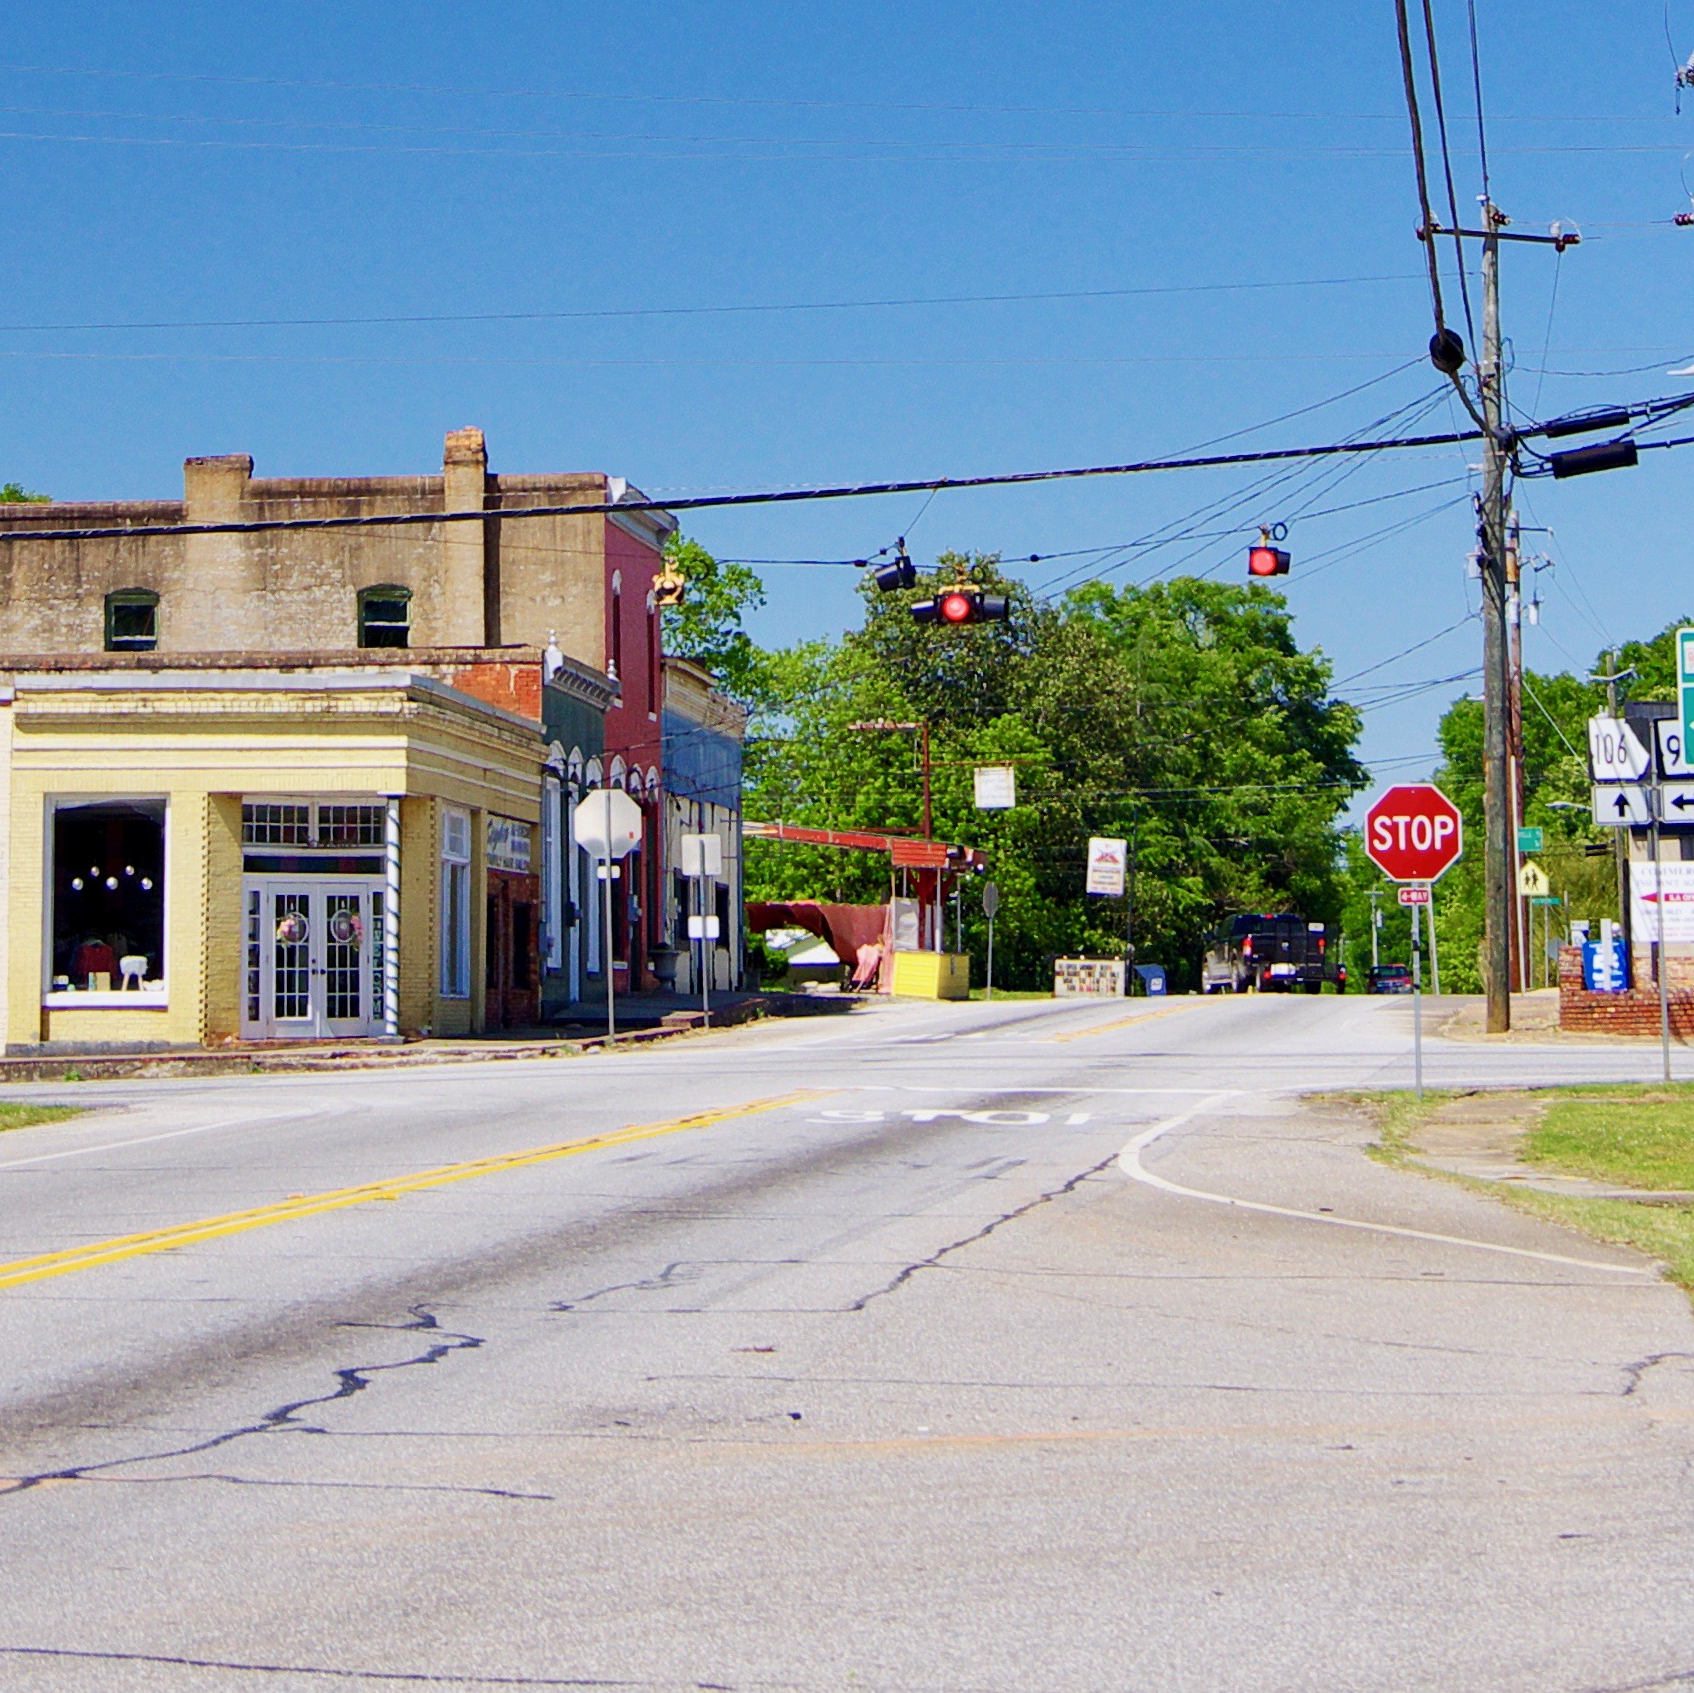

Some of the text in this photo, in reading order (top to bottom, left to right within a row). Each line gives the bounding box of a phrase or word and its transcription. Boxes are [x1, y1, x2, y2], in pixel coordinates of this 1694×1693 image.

[1596, 733, 1627, 765] 106
[1667, 734, 1681, 766] 9
[1373, 814, 1454, 851] STOP
